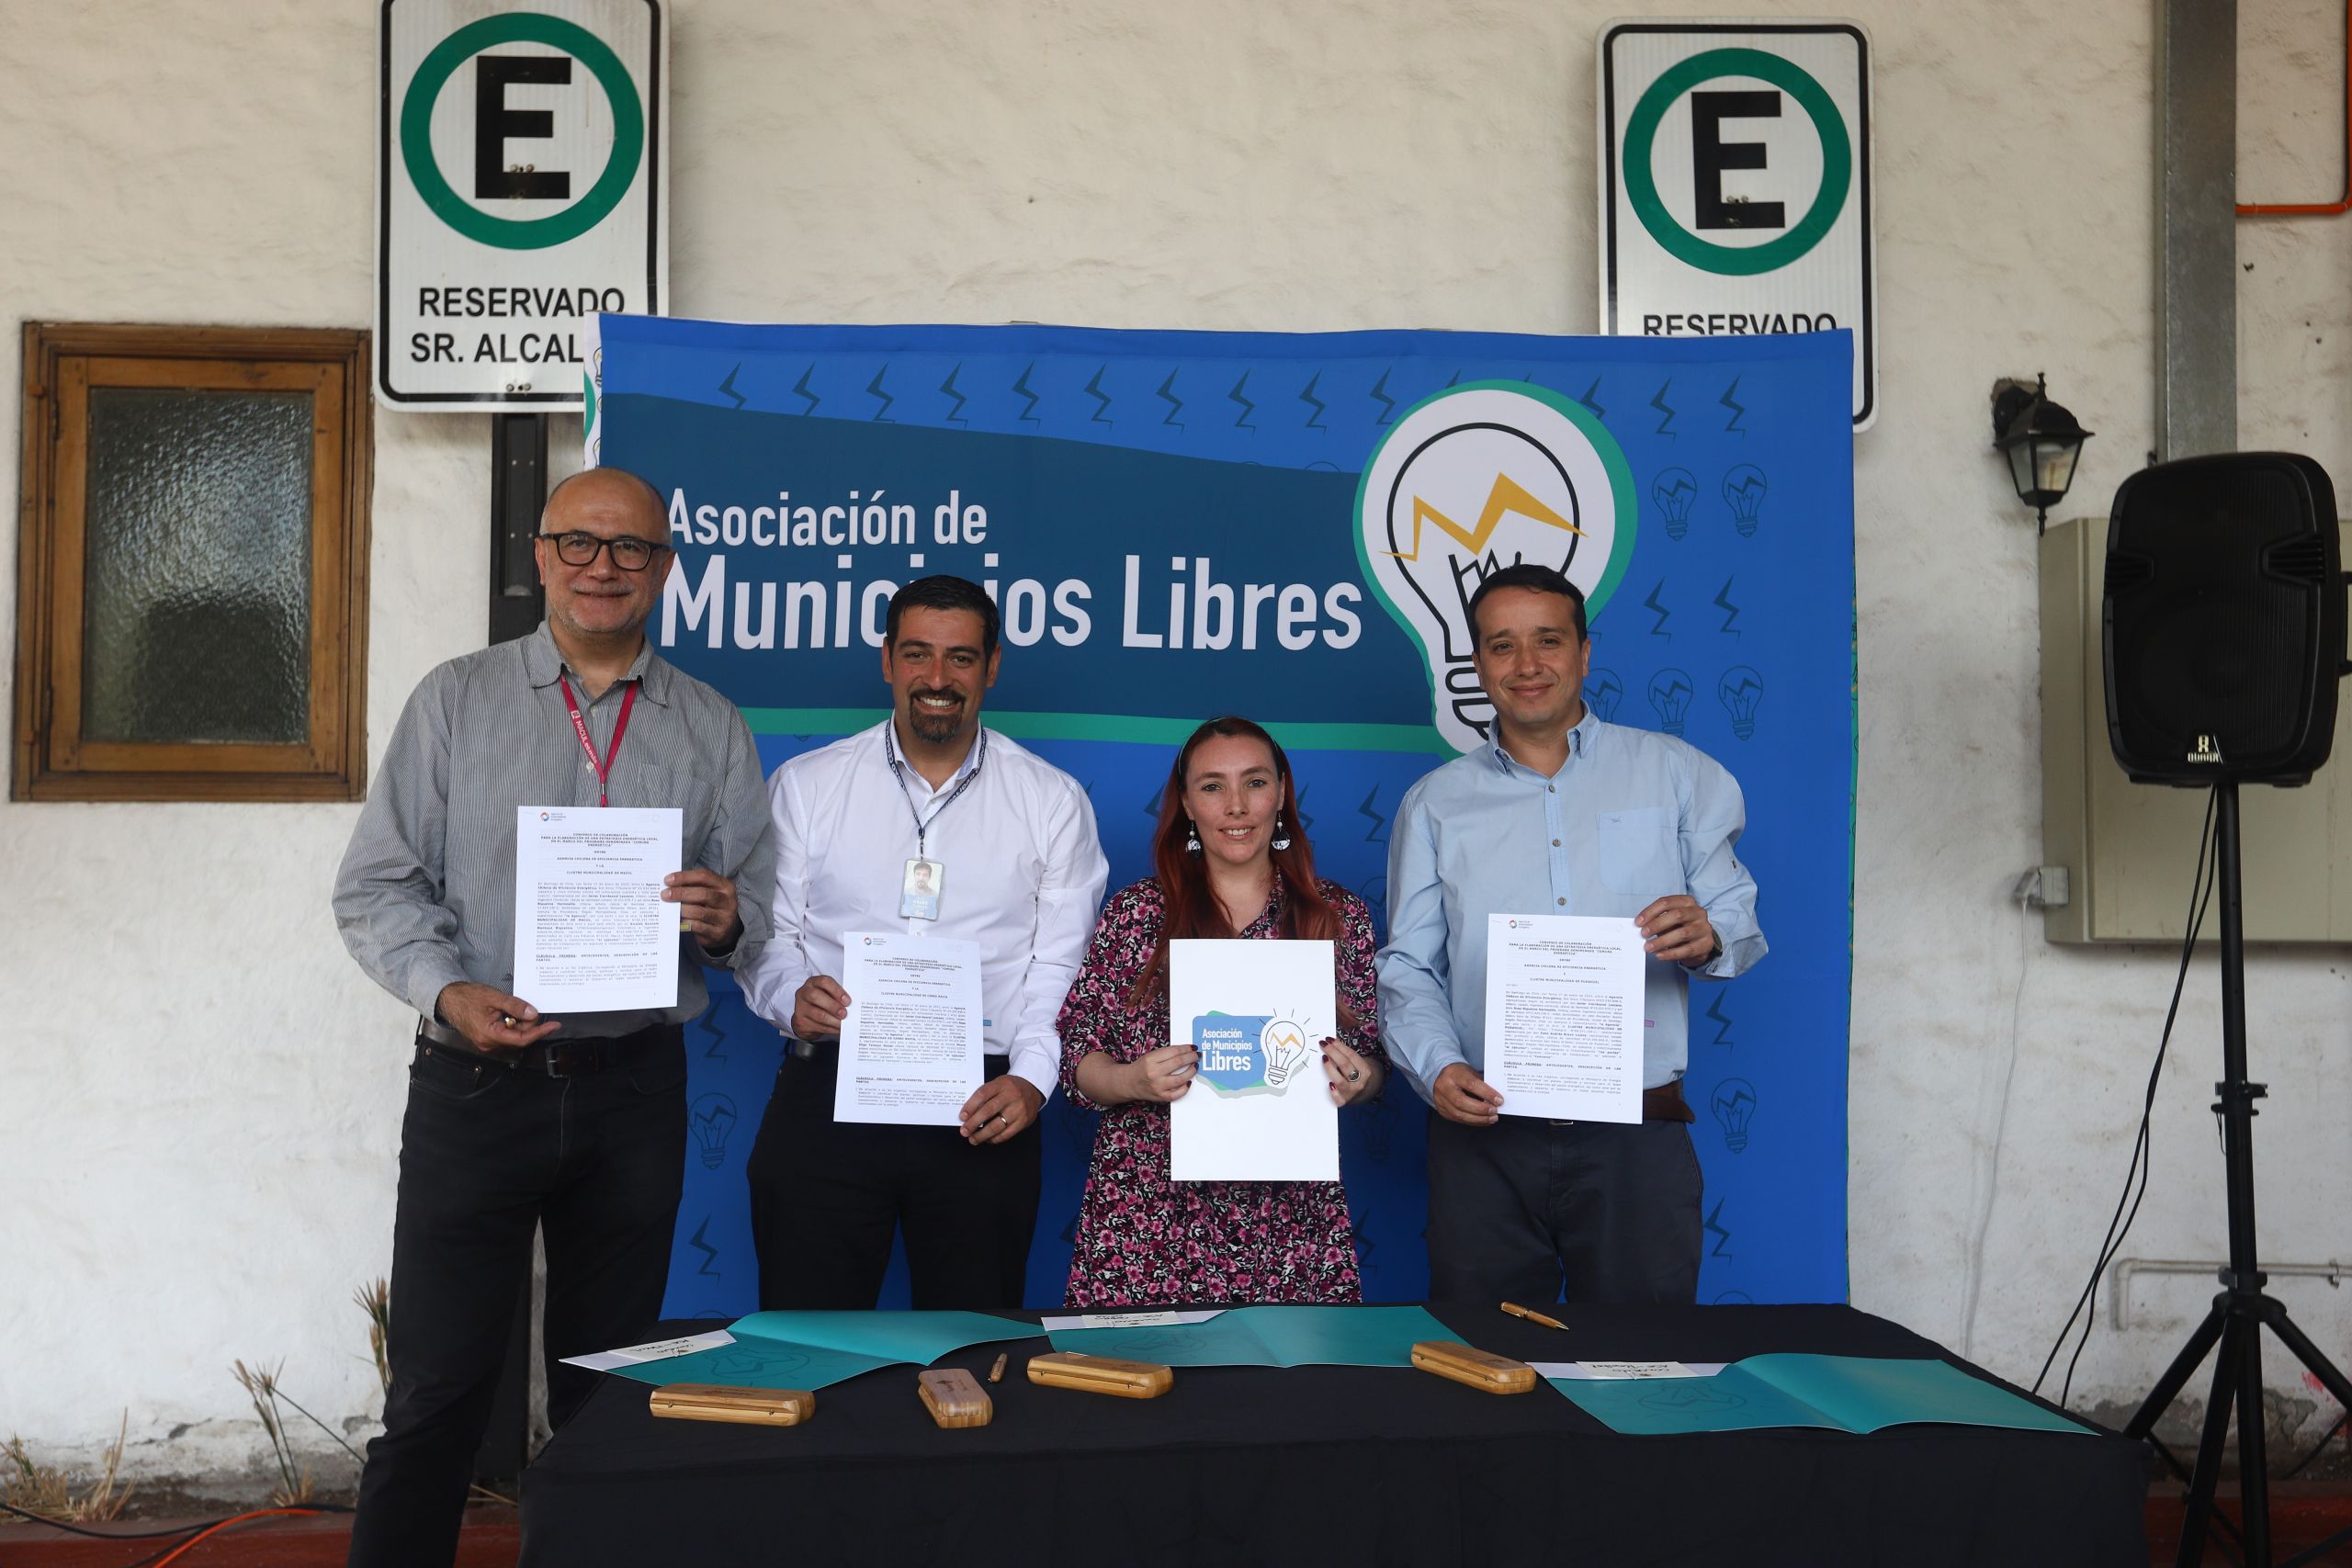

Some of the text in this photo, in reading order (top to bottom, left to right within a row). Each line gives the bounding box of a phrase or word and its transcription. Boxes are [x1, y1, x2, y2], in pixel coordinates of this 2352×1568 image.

[474, 55, 571, 200] E
[1690, 90, 1786, 230] E
[419, 287, 626, 317] RESERVADO
[1643, 312, 1838, 335] RESERVADO
[411, 333, 584, 363] SR. ALCAL
[668, 488, 988, 547] Asociación de
[661, 552, 1363, 650] Municos Libres
[1201, 1040, 1253, 1053] de Municipios
[1202, 1028, 1243, 1039] Asociación
[1202, 1050, 1251, 1071] Libres
